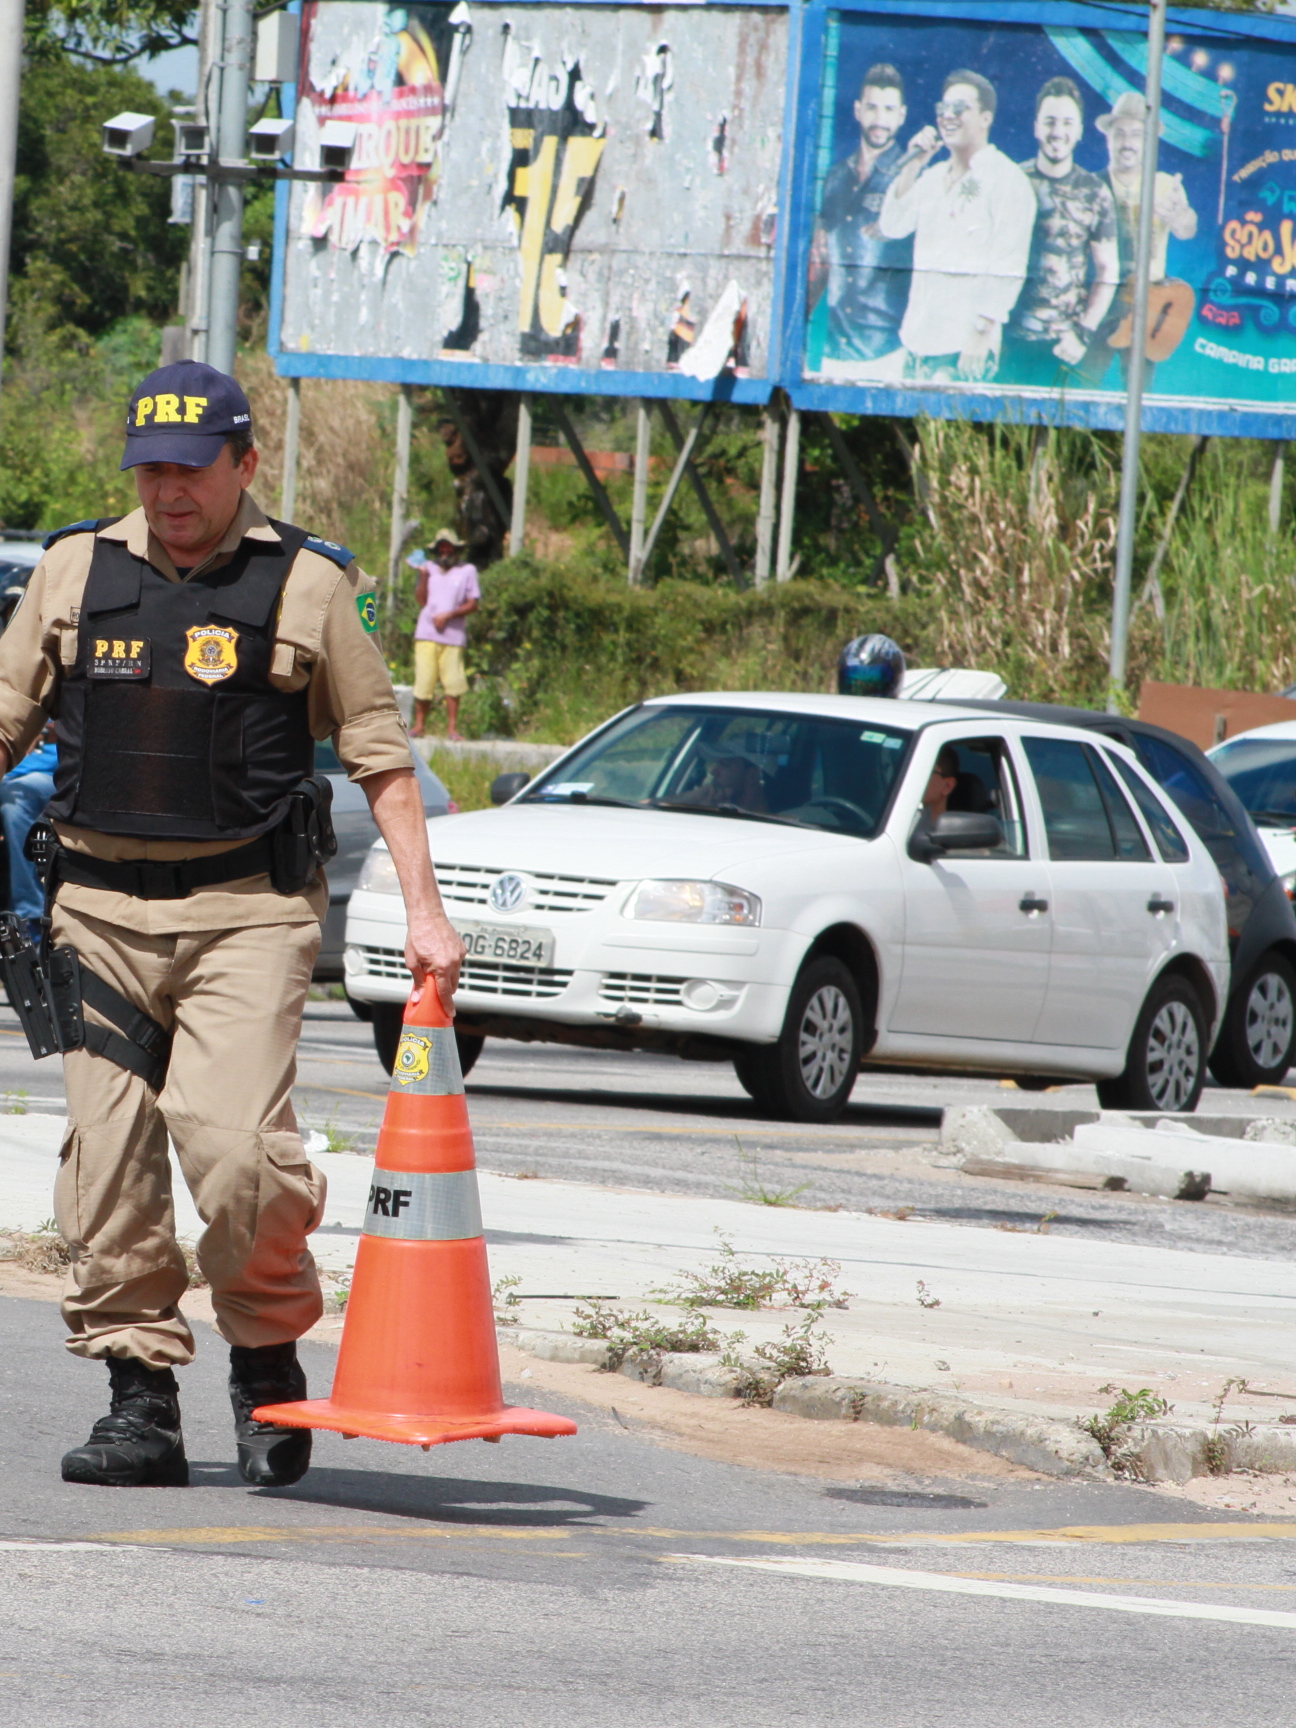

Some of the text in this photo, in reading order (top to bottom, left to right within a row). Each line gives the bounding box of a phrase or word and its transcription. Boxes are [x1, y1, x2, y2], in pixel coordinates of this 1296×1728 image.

[1194, 336, 1265, 371] CAMPINA
[135, 393, 208, 427] PRF
[95, 639, 144, 658] PRF
